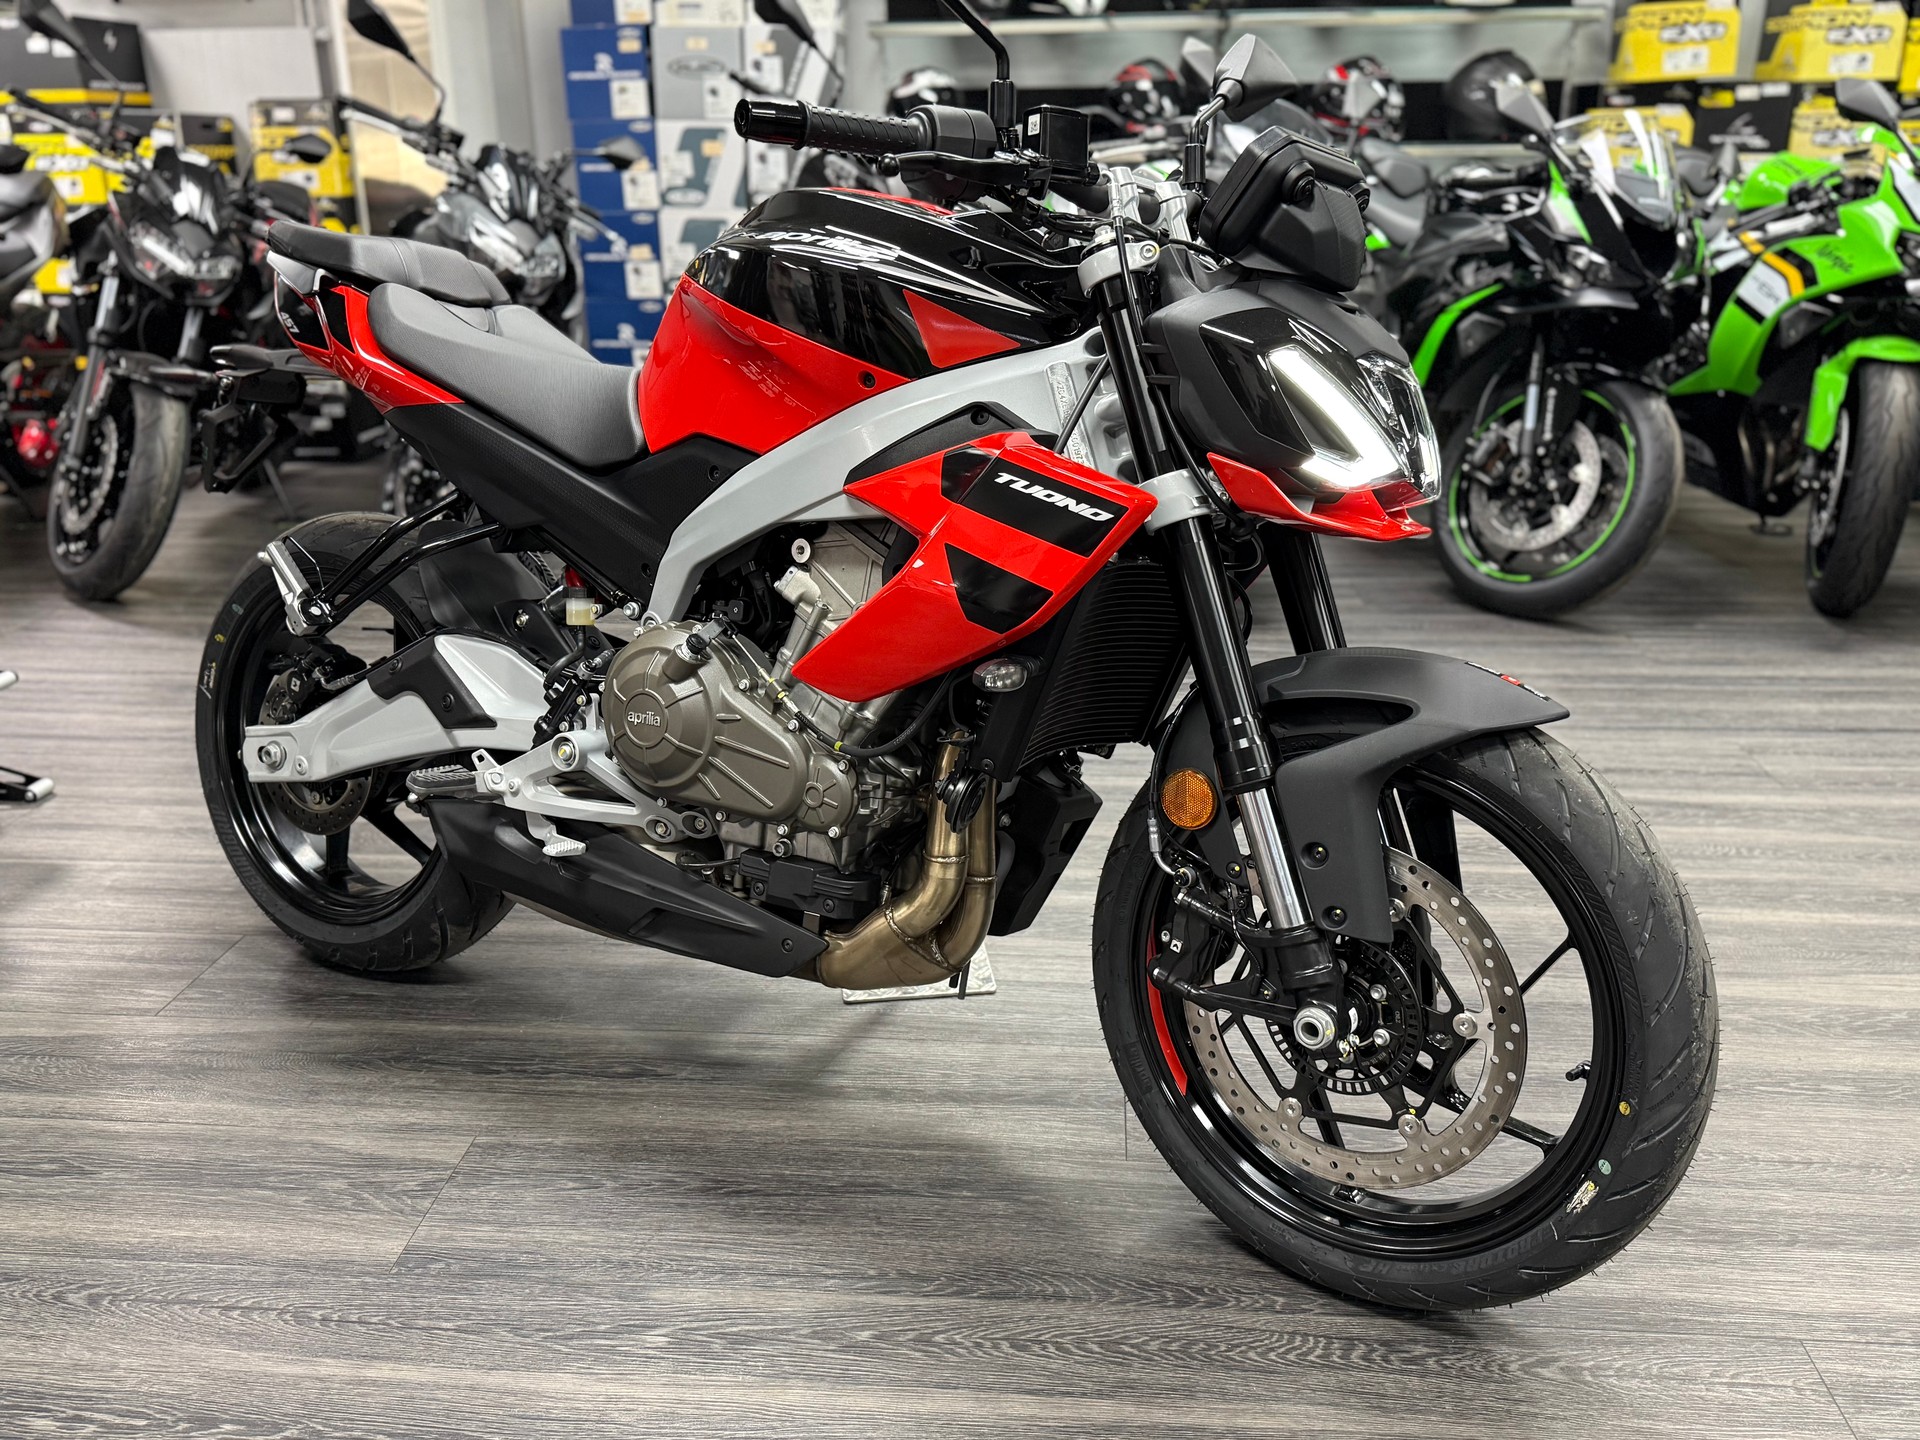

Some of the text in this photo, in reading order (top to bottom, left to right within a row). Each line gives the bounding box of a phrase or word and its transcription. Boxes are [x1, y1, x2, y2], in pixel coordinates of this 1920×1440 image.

[280, 311, 300, 334] 457
[993, 472, 1115, 522] TUONO
[627, 710, 661, 727] aprilia
